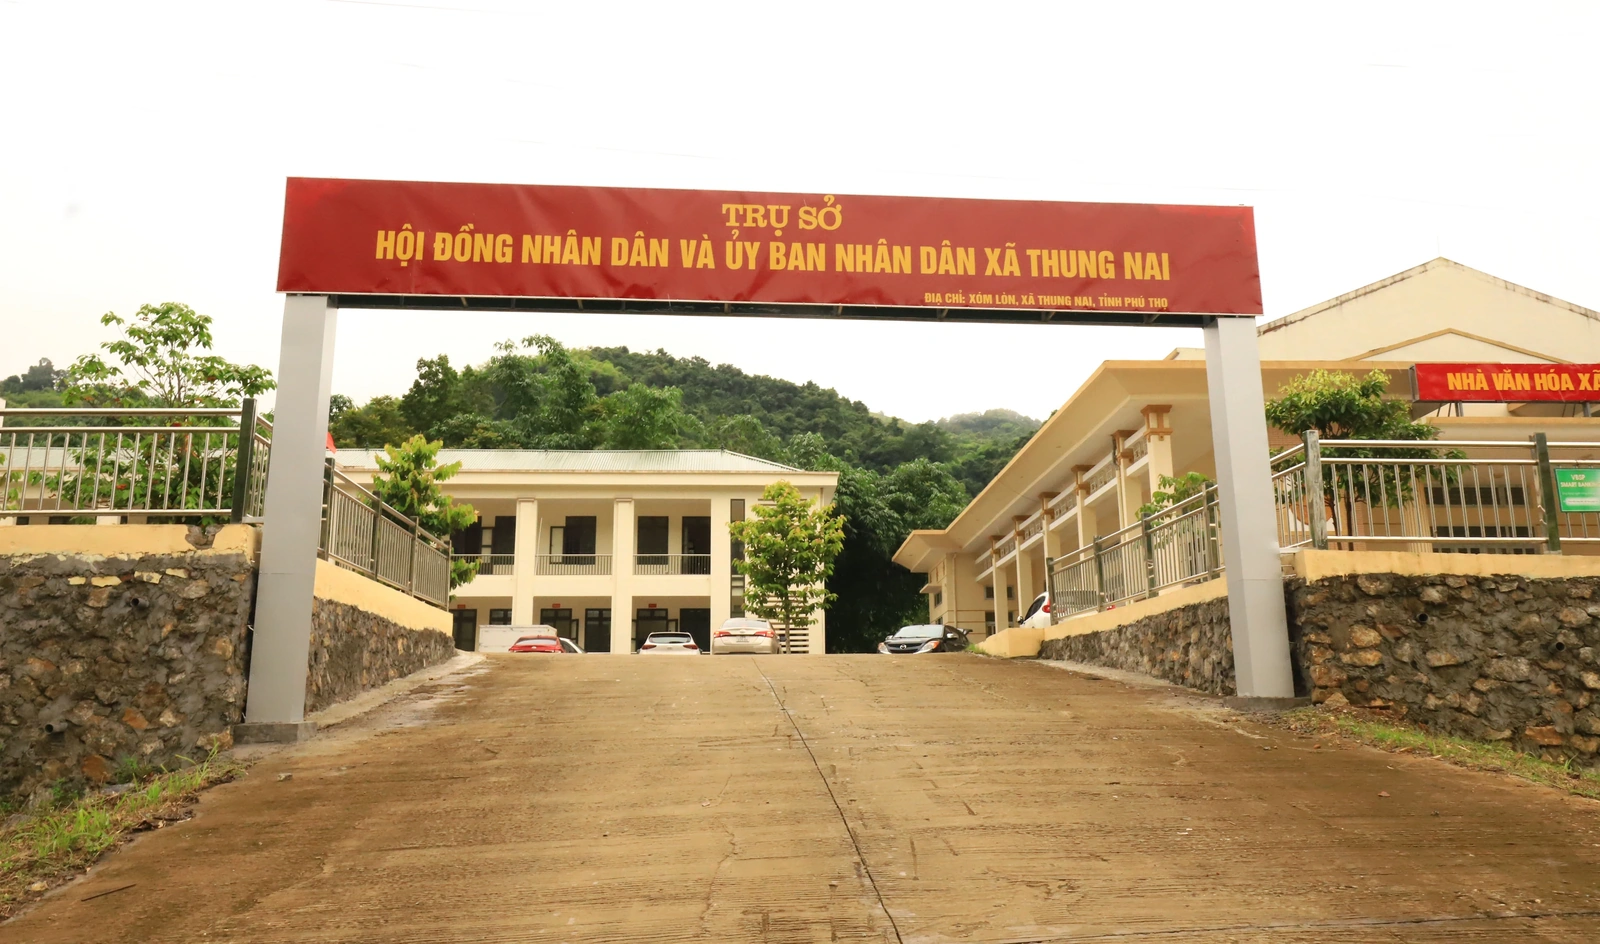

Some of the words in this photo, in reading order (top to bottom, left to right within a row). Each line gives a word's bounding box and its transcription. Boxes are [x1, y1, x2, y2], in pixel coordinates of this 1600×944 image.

[722, 203, 791, 237] TRỤ
[798, 194, 843, 231] SỞ
[376, 223, 425, 267] HỘI
[433, 223, 514, 263] ĐỒNG
[521, 229, 602, 266] NHÂN
[611, 230, 669, 268] DÂN
[680, 234, 716, 269] VÀ
[725, 228, 761, 272] ỦY
[769, 241, 826, 272] BAN
[835, 238, 912, 274] NHÂN
[920, 239, 976, 276] DÂN
[984, 242, 1021, 277] XÃ
[1026, 249, 1116, 279] THUNG
[1123, 251, 1170, 281] NAI
[944, 290, 966, 304] CHỈ:
[969, 292, 993, 304] XÓM
[1021, 293, 1036, 305] XÃ
[1038, 295, 1072, 306] THUNG
[1074, 296, 1096, 307] NAI,
[1098, 293, 1123, 308] TỈNH
[1124, 296, 1146, 308] PHÚ
[1148, 298, 1169, 310] THỌ
[1447, 369, 1489, 390] NHÀ
[1492, 369, 1531, 391] VĂN
[1534, 369, 1575, 391] HÓA
